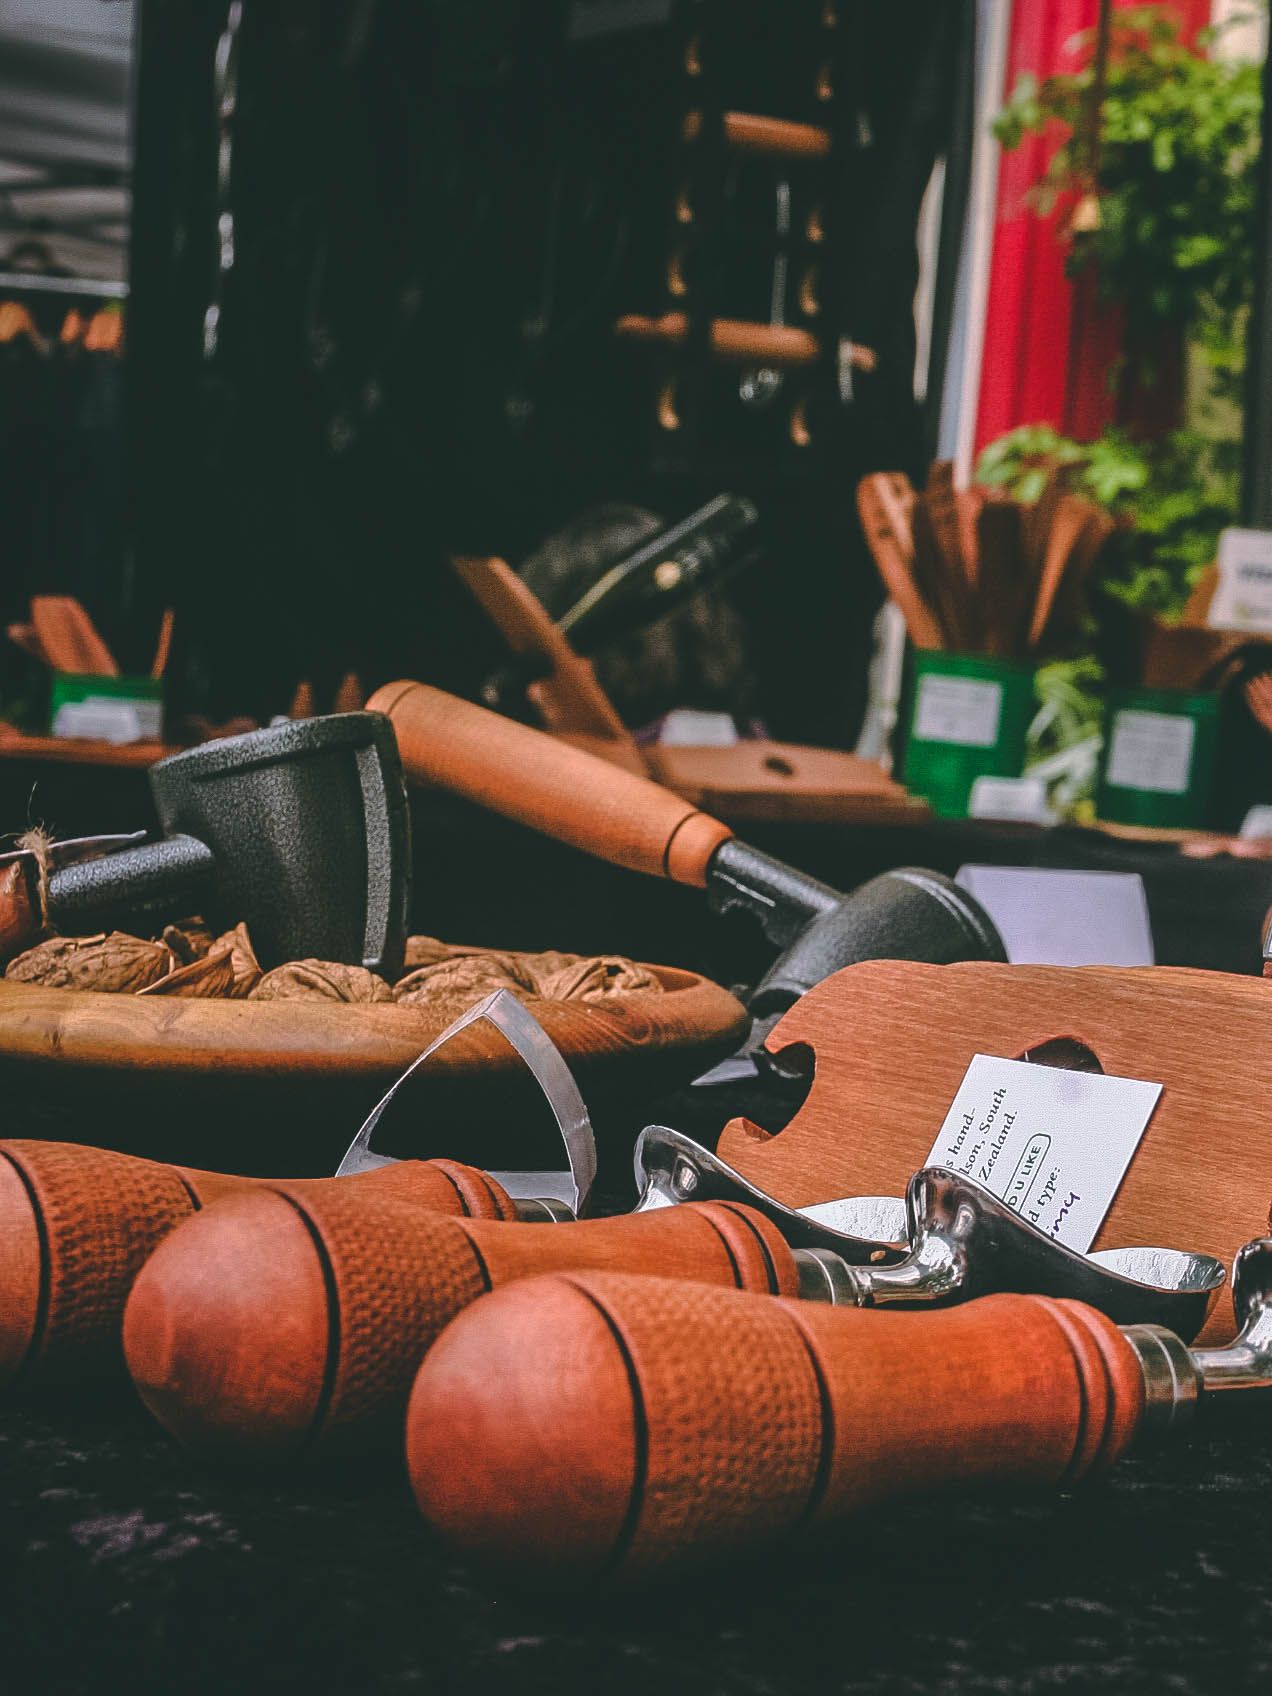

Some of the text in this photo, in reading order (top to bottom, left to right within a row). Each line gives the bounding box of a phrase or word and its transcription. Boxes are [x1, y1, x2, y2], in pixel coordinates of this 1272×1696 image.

[947, 1107, 976, 1156] hand-
[978, 1087, 1007, 1135] South
[977, 1110, 1018, 1181] Zealand.
[1014, 1180, 1025, 1191] U
[1021, 1145, 1042, 1176] LIKE
[1037, 1166, 1061, 1207] type:
